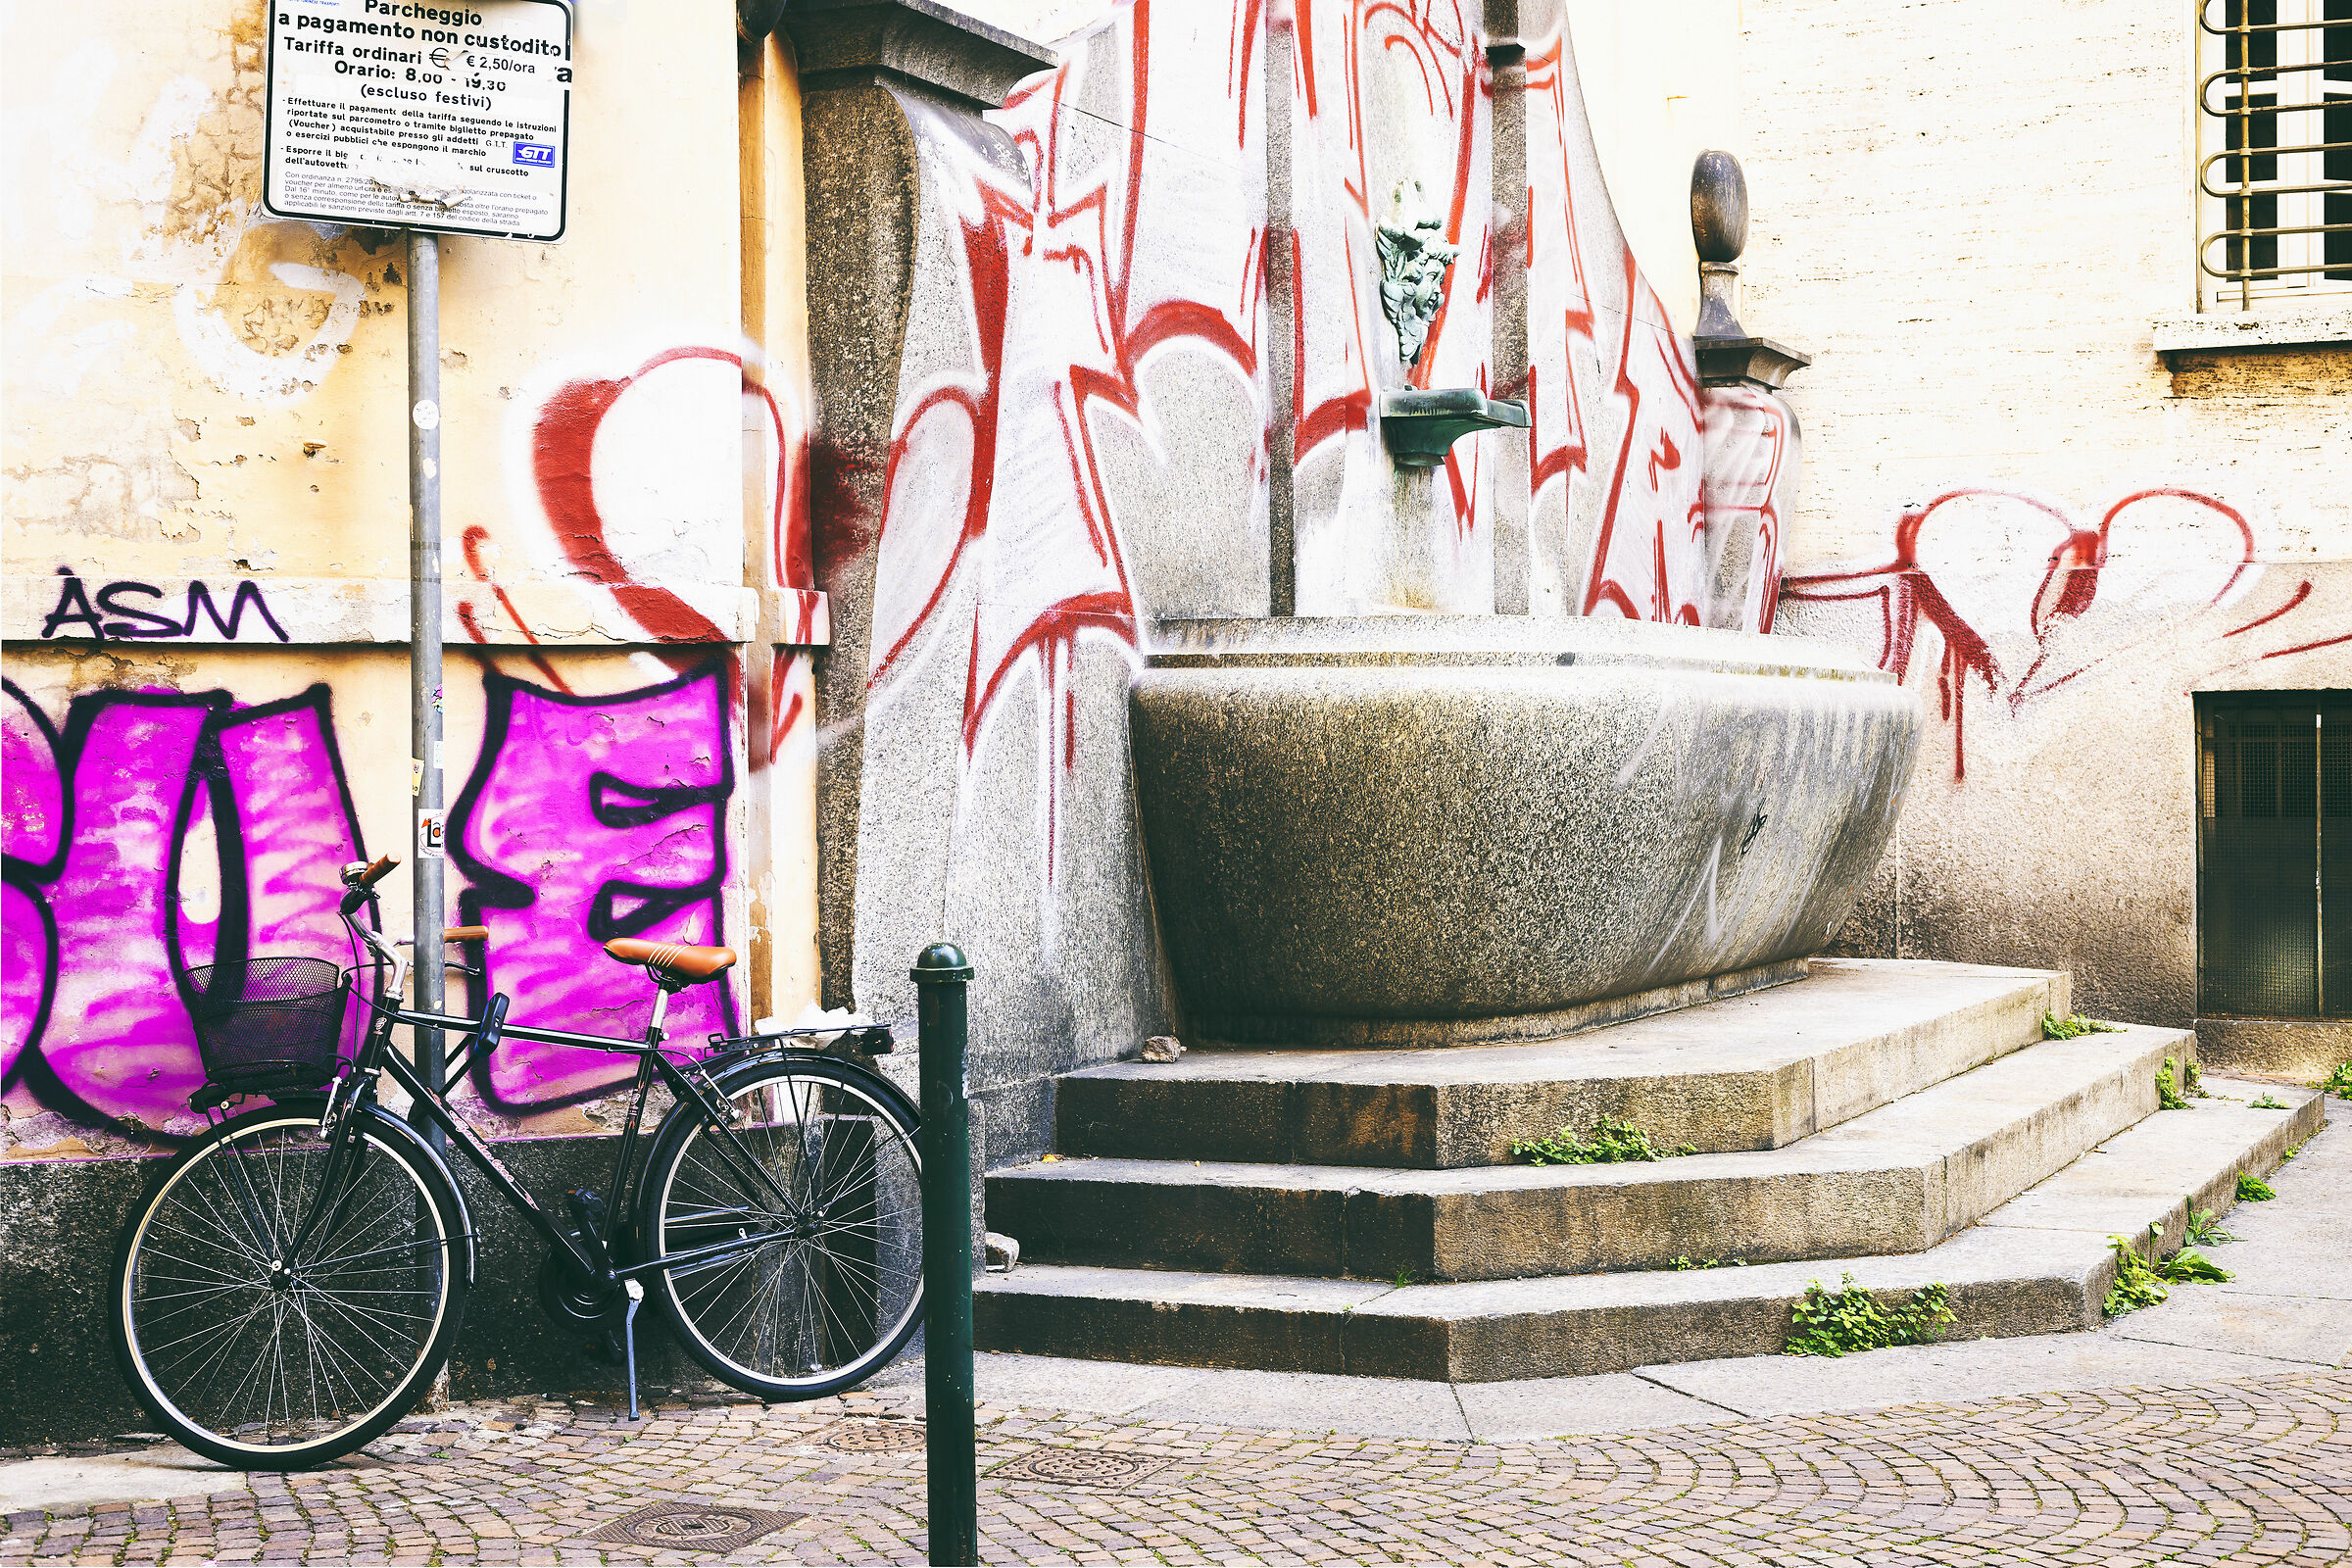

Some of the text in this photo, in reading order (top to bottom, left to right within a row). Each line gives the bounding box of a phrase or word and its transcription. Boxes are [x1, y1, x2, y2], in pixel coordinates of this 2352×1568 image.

[365, 0, 482, 26] Parcheggio
[278, 13, 562, 57] a pagamento non custodito
[284, 36, 344, 56] Tariffa
[353, 47, 422, 65] ordinari
[480, 56, 535, 74] 2,50/ora
[334, 60, 396, 79] Orario:
[361, 83, 492, 112] (escluso festivi)
[287, 97, 336, 110] Effettuare
[402, 110, 424, 119] della
[428, 112, 457, 122] tariffa
[461, 116, 502, 126] seguendo
[505, 120, 514, 128] le
[516, 122, 557, 133] istruzioni
[287, 108, 328, 119] riportate
[349, 115, 401, 126] parcometro
[413, 121, 447, 131] tramite
[450, 124, 487, 135] biglietto
[490, 129, 534, 141] prepagato
[295, 131, 330, 141] esercizi
[333, 135, 368, 145] pubblici
[391, 142, 440, 152] espongono
[442, 144, 448, 153] il
[452, 146, 487, 157] marchio
[340, 124, 395, 136] acquistabile
[399, 131, 429, 141] presso
[431, 133, 444, 142] gli
[447, 135, 479, 146] addetti
[286, 145, 322, 156] Esporre
[486, 166, 529, 176] cruscotto
[517, 146, 552, 161] GTT
[301, 172, 335, 181] ordinanza
[327, 182, 354, 191] almeno
[358, 207, 385, 216] previste
[386, 209, 404, 218] dagli
[458, 215, 480, 223] codice
[481, 216, 498, 224] della
[499, 218, 520, 226] strada
[360, 192, 372, 201] per
[514, 207, 549, 216] prepagato
